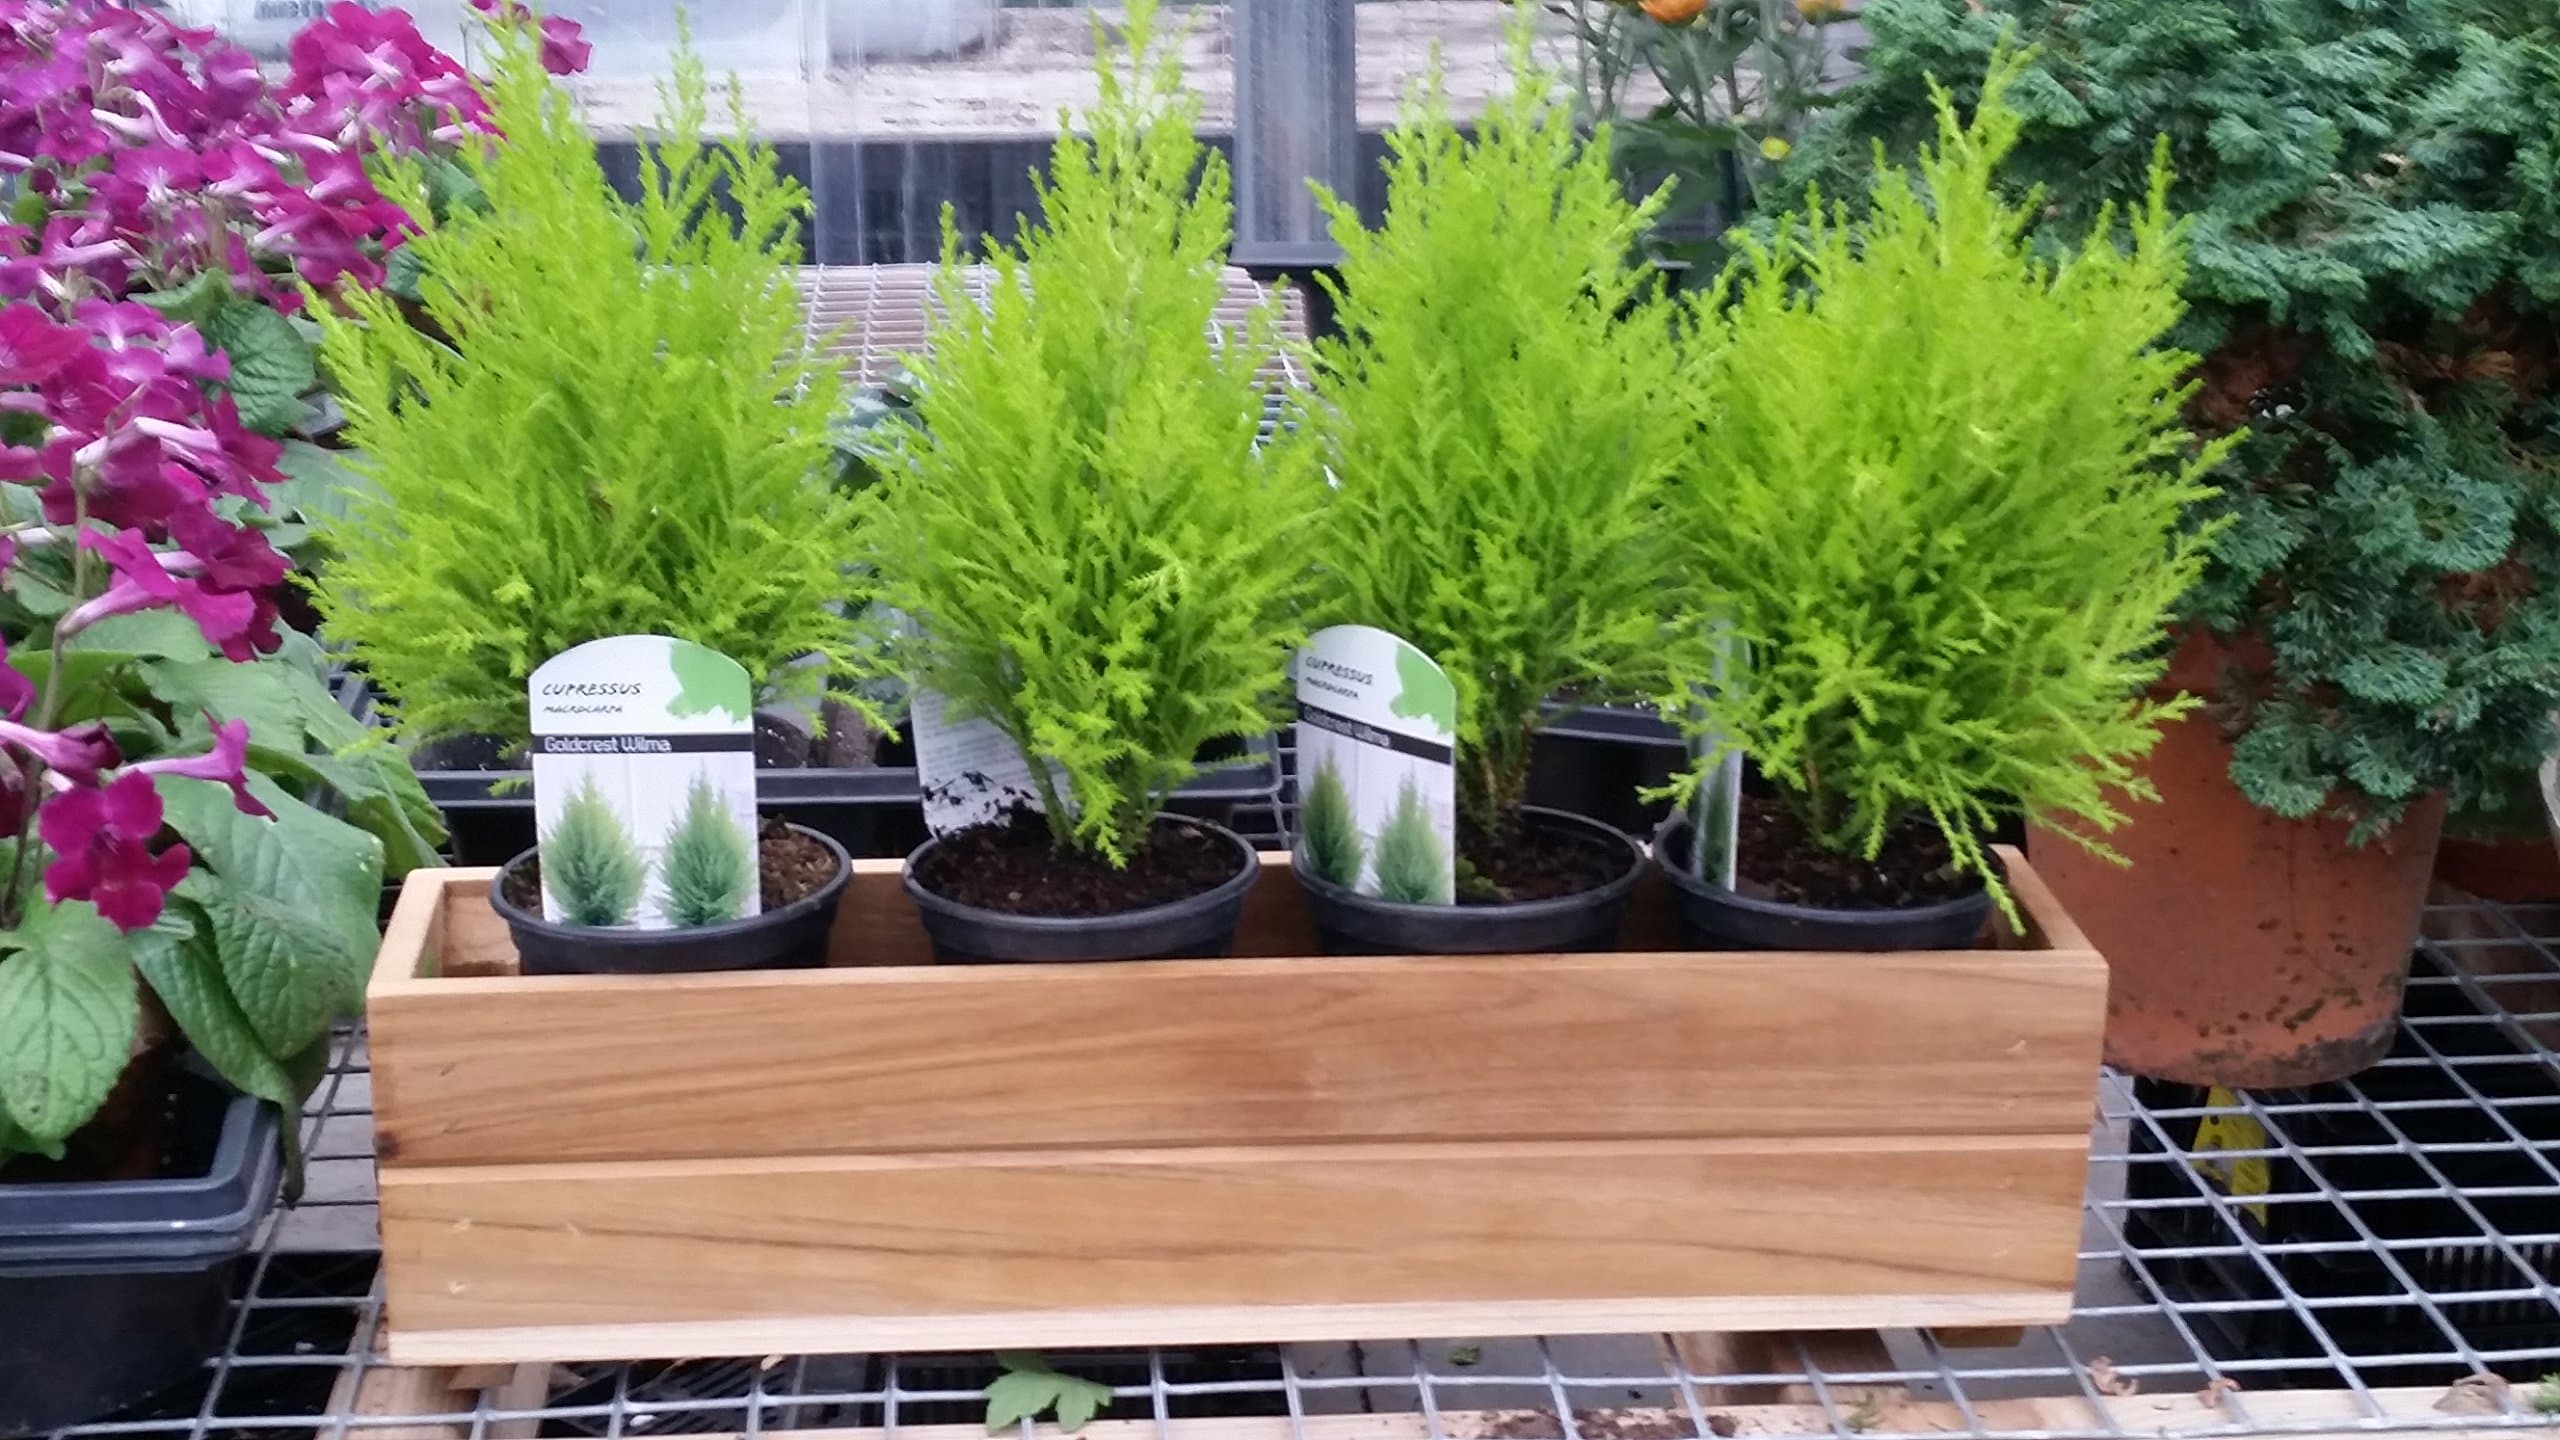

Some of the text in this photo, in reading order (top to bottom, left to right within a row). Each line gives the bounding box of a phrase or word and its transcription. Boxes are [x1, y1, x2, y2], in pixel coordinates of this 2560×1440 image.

[1305, 656, 1374, 685] CUPRESSUS
[542, 683, 641, 696] CUPRESSUS
[544, 736, 672, 753] Goldcrest Wilma
